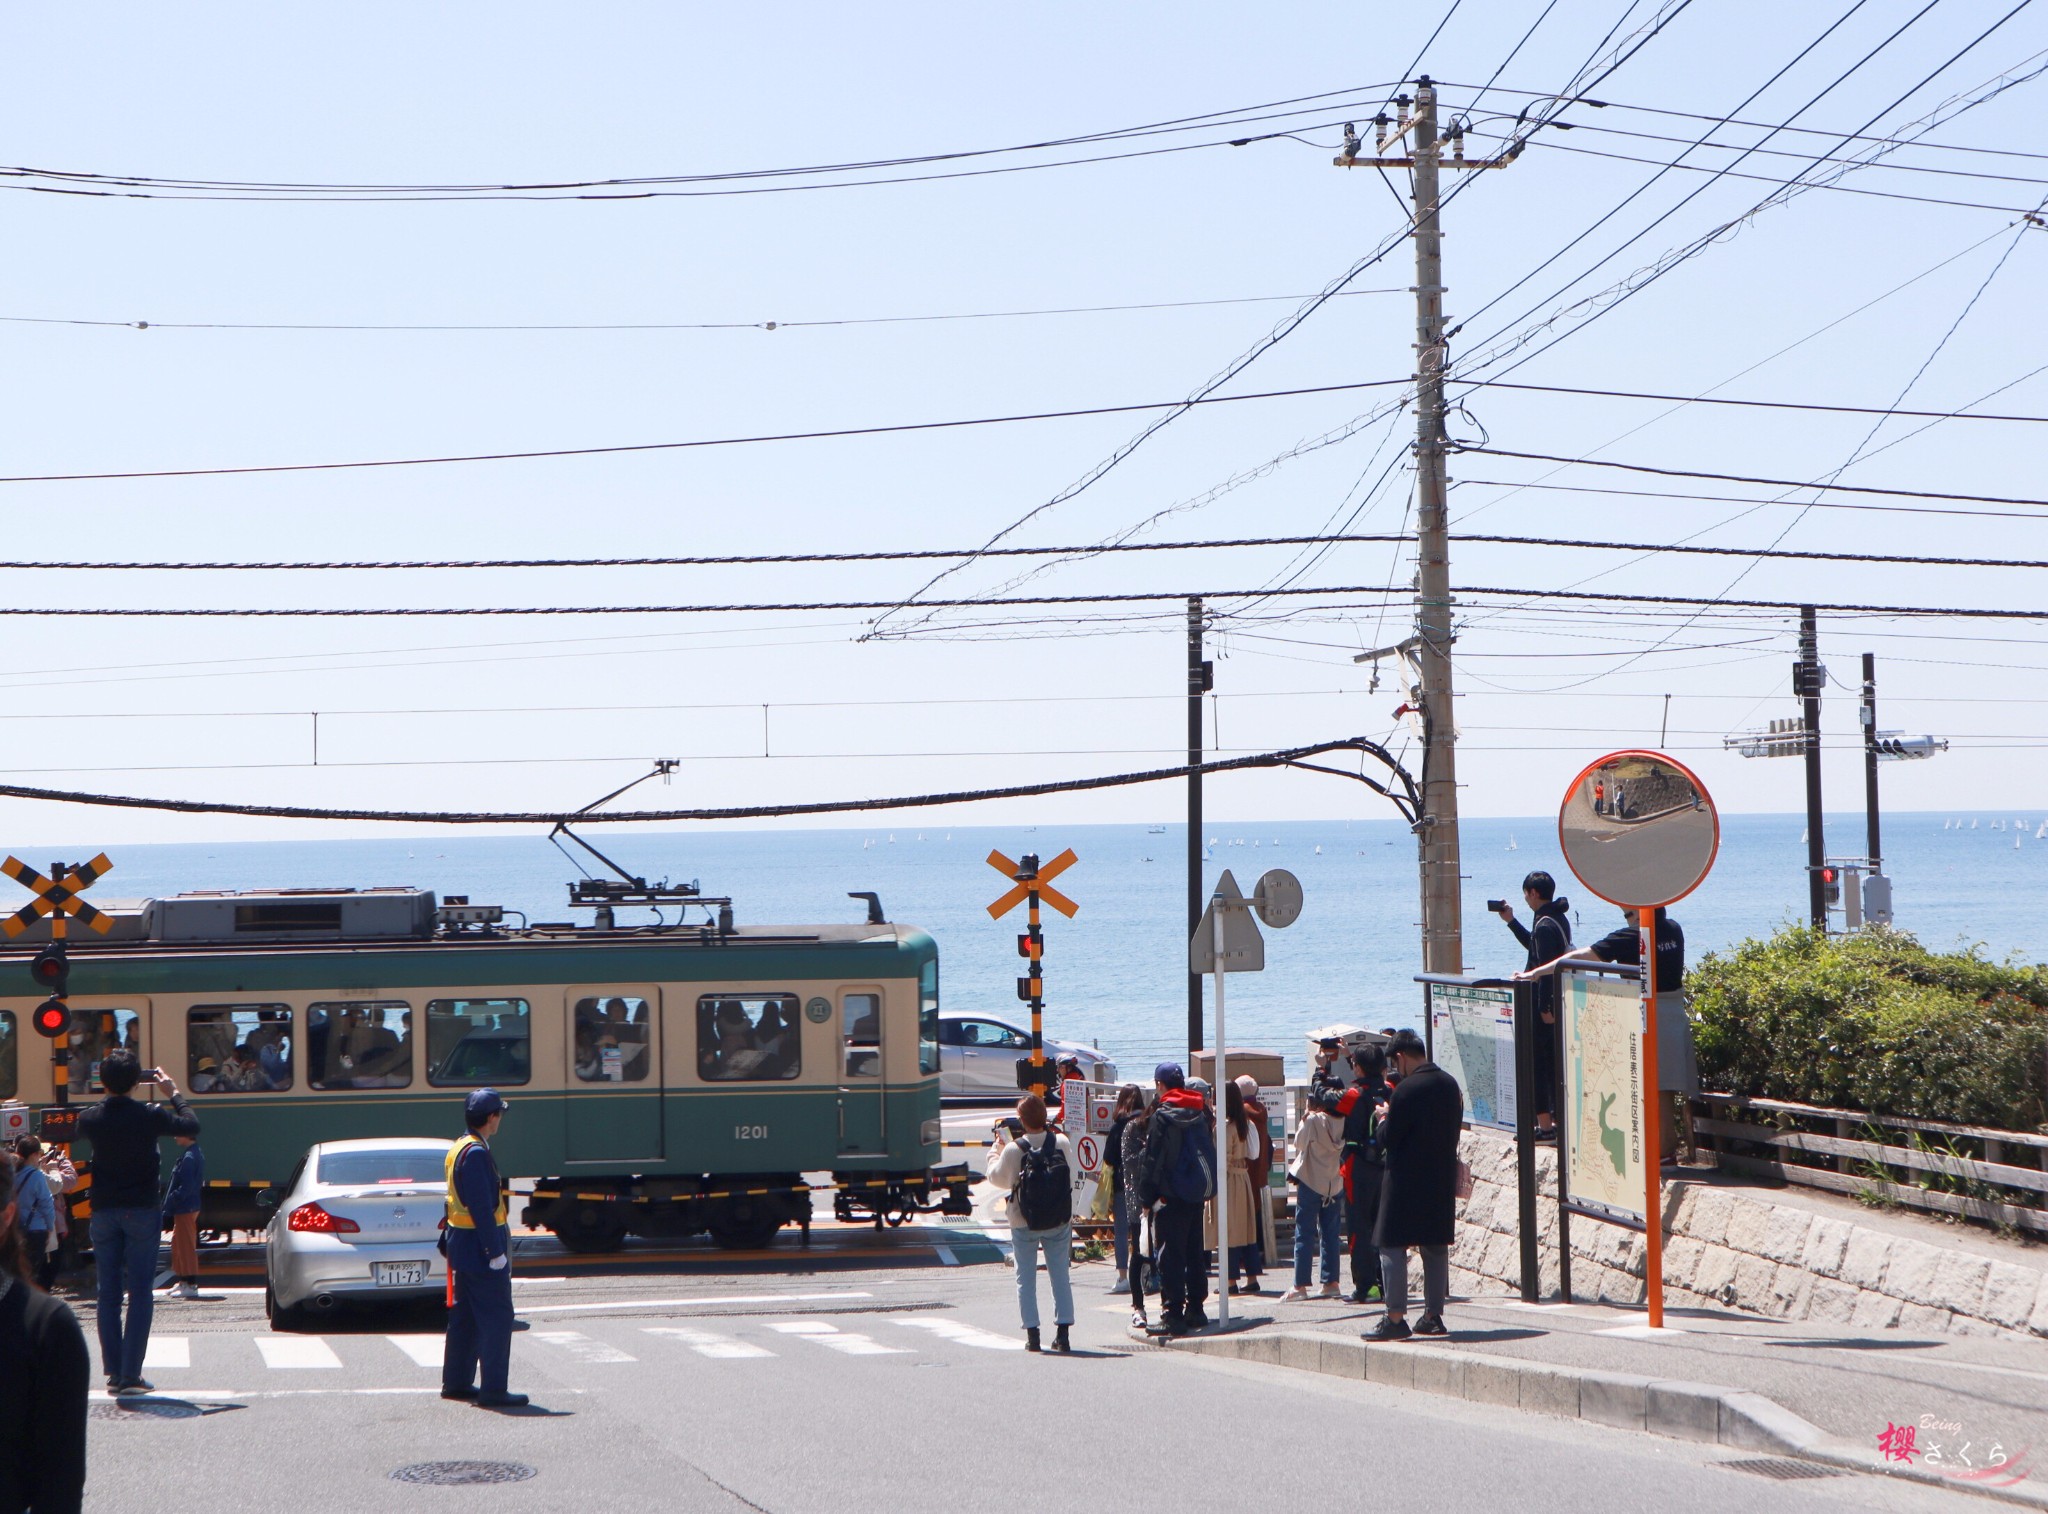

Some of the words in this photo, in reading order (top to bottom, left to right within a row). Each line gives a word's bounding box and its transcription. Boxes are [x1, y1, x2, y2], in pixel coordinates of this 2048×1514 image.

[1629, 1031, 1640, 1164] 住居表示街区案内図
[43, 1112, 80, 1124] ふみき
[735, 1125, 768, 1139] 1201
[389, 1270, 421, 1284] 11-73
